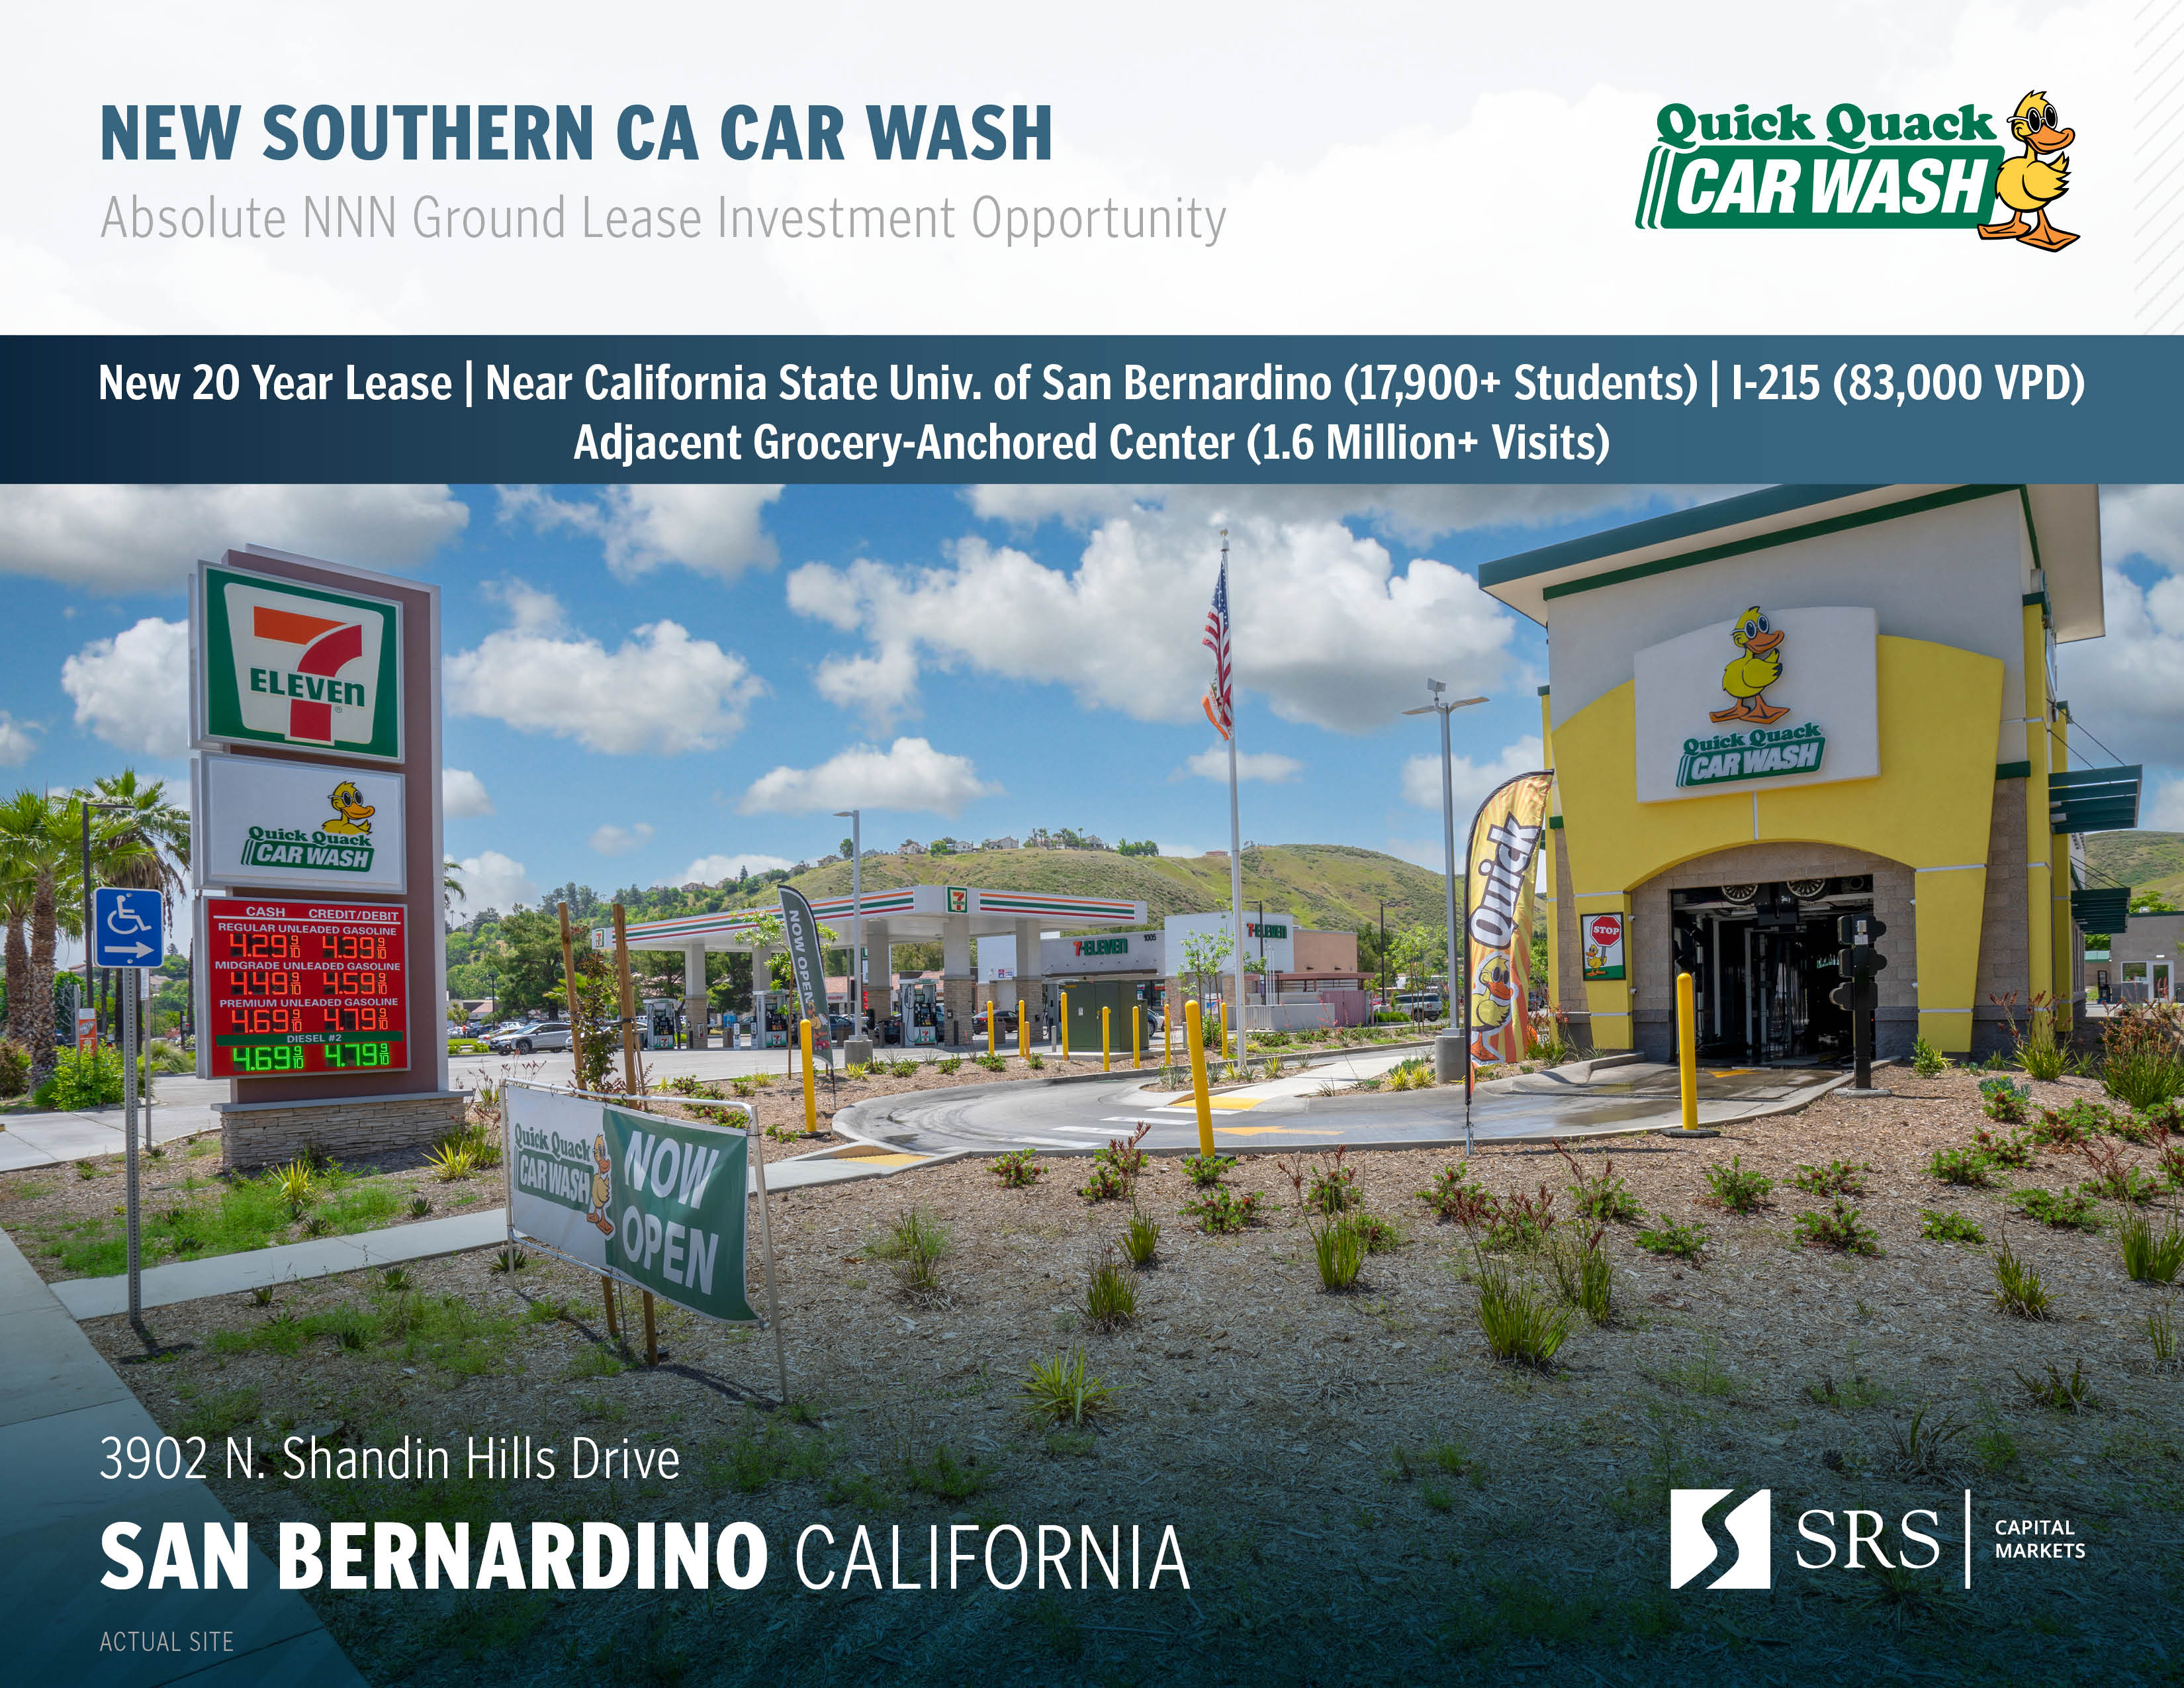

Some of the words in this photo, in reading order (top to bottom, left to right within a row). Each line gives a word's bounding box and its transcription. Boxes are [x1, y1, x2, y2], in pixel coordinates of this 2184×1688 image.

[253, 606, 362, 741] 7
[1684, 733, 1745, 755] Quick
[1749, 722, 1821, 746] Quack
[1691, 753, 1741, 780] CAR
[1743, 742, 1819, 774] WASH
[249, 826, 308, 841] Quick
[312, 831, 371, 846] Quack
[257, 844, 303, 863] CAR
[307, 847, 369, 867] WASH
[1471, 812, 1541, 949] Quick
[246, 907, 285, 917] CASH
[308, 909, 399, 921] CREDIT/DEBIT
[218, 923, 275, 932] REGULAR
[279, 925, 340, 934] UNLEADED
[343, 927, 396, 935] GASOLINE
[1593, 926, 1620, 935] STOP
[230, 933, 287, 958] 4.29
[322, 935, 375, 959] 4.39
[789, 910, 805, 952] NOW
[797, 957, 815, 1003] OPEN
[215, 961, 280, 970] MIDGRADE
[283, 962, 344, 970] UNLEADED
[231, 972, 287, 995] 4.49
[323, 972, 375, 994] 4.59
[220, 999, 277, 1008] PREMIUM
[281, 998, 341, 1007] UNLEADED
[344, 998, 398, 1006] GASOLINE
[232, 1009, 289, 1033] 4.69
[324, 1008, 375, 1031] 4.79
[287, 1035, 325, 1043] DIESEL
[233, 1046, 290, 1071] 4.69
[324, 1043, 377, 1067] 4.79
[514, 1123, 549, 1150] Quick
[551, 1131, 591, 1162] Quack
[520, 1154, 546, 1190] CAR
[549, 1161, 591, 1205] WASH
[624, 1130, 719, 1209] NOW
[622, 1205, 719, 1295] OPEN
